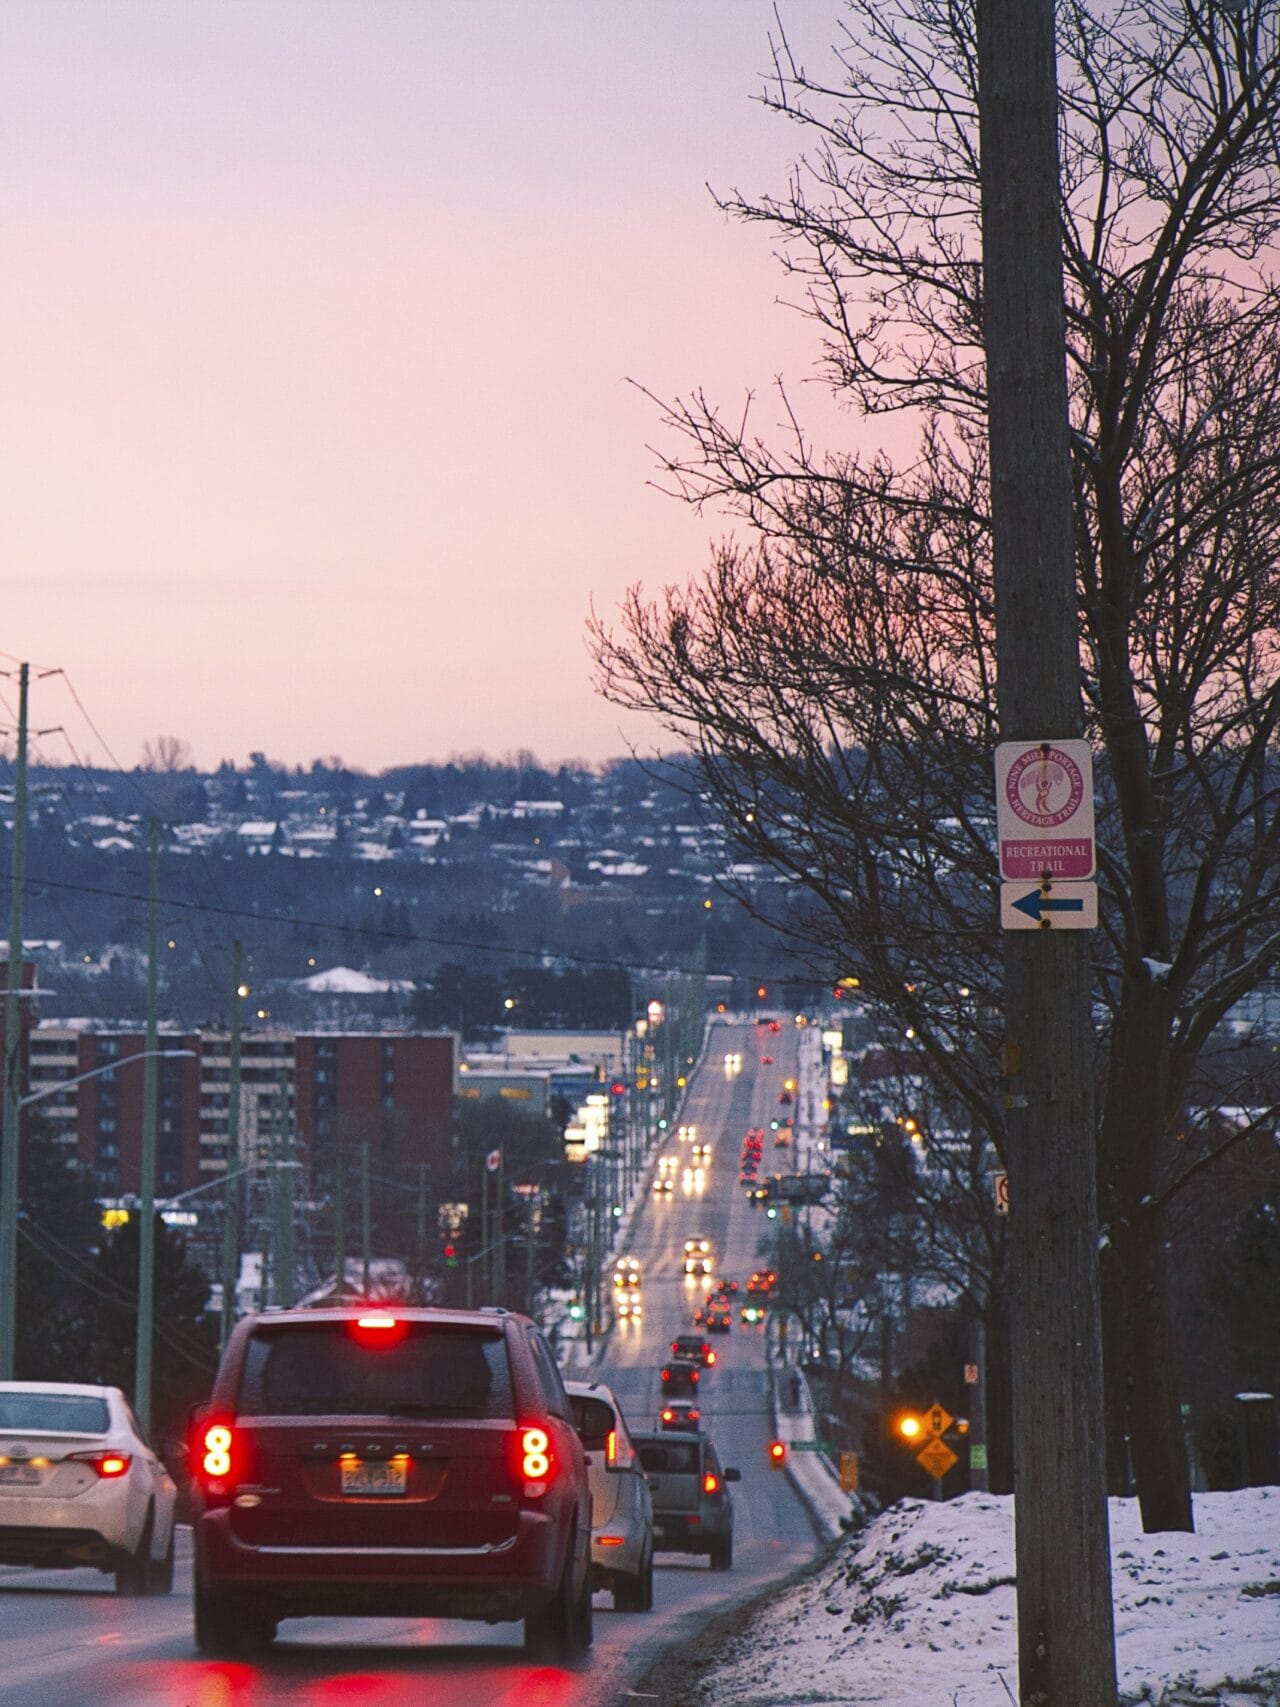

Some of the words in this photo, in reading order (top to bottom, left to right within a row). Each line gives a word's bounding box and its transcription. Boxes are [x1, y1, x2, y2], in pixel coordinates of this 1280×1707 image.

[1008, 763, 1024, 789] NINE
[1048, 750, 1081, 788] PORTAGE
[1011, 799, 1055, 825] HERITAGE
[1057, 798, 1079, 820] TRAIL
[1006, 845, 1088, 858] RECREATIONAL
[1030, 860, 1065, 872] TRAIL
